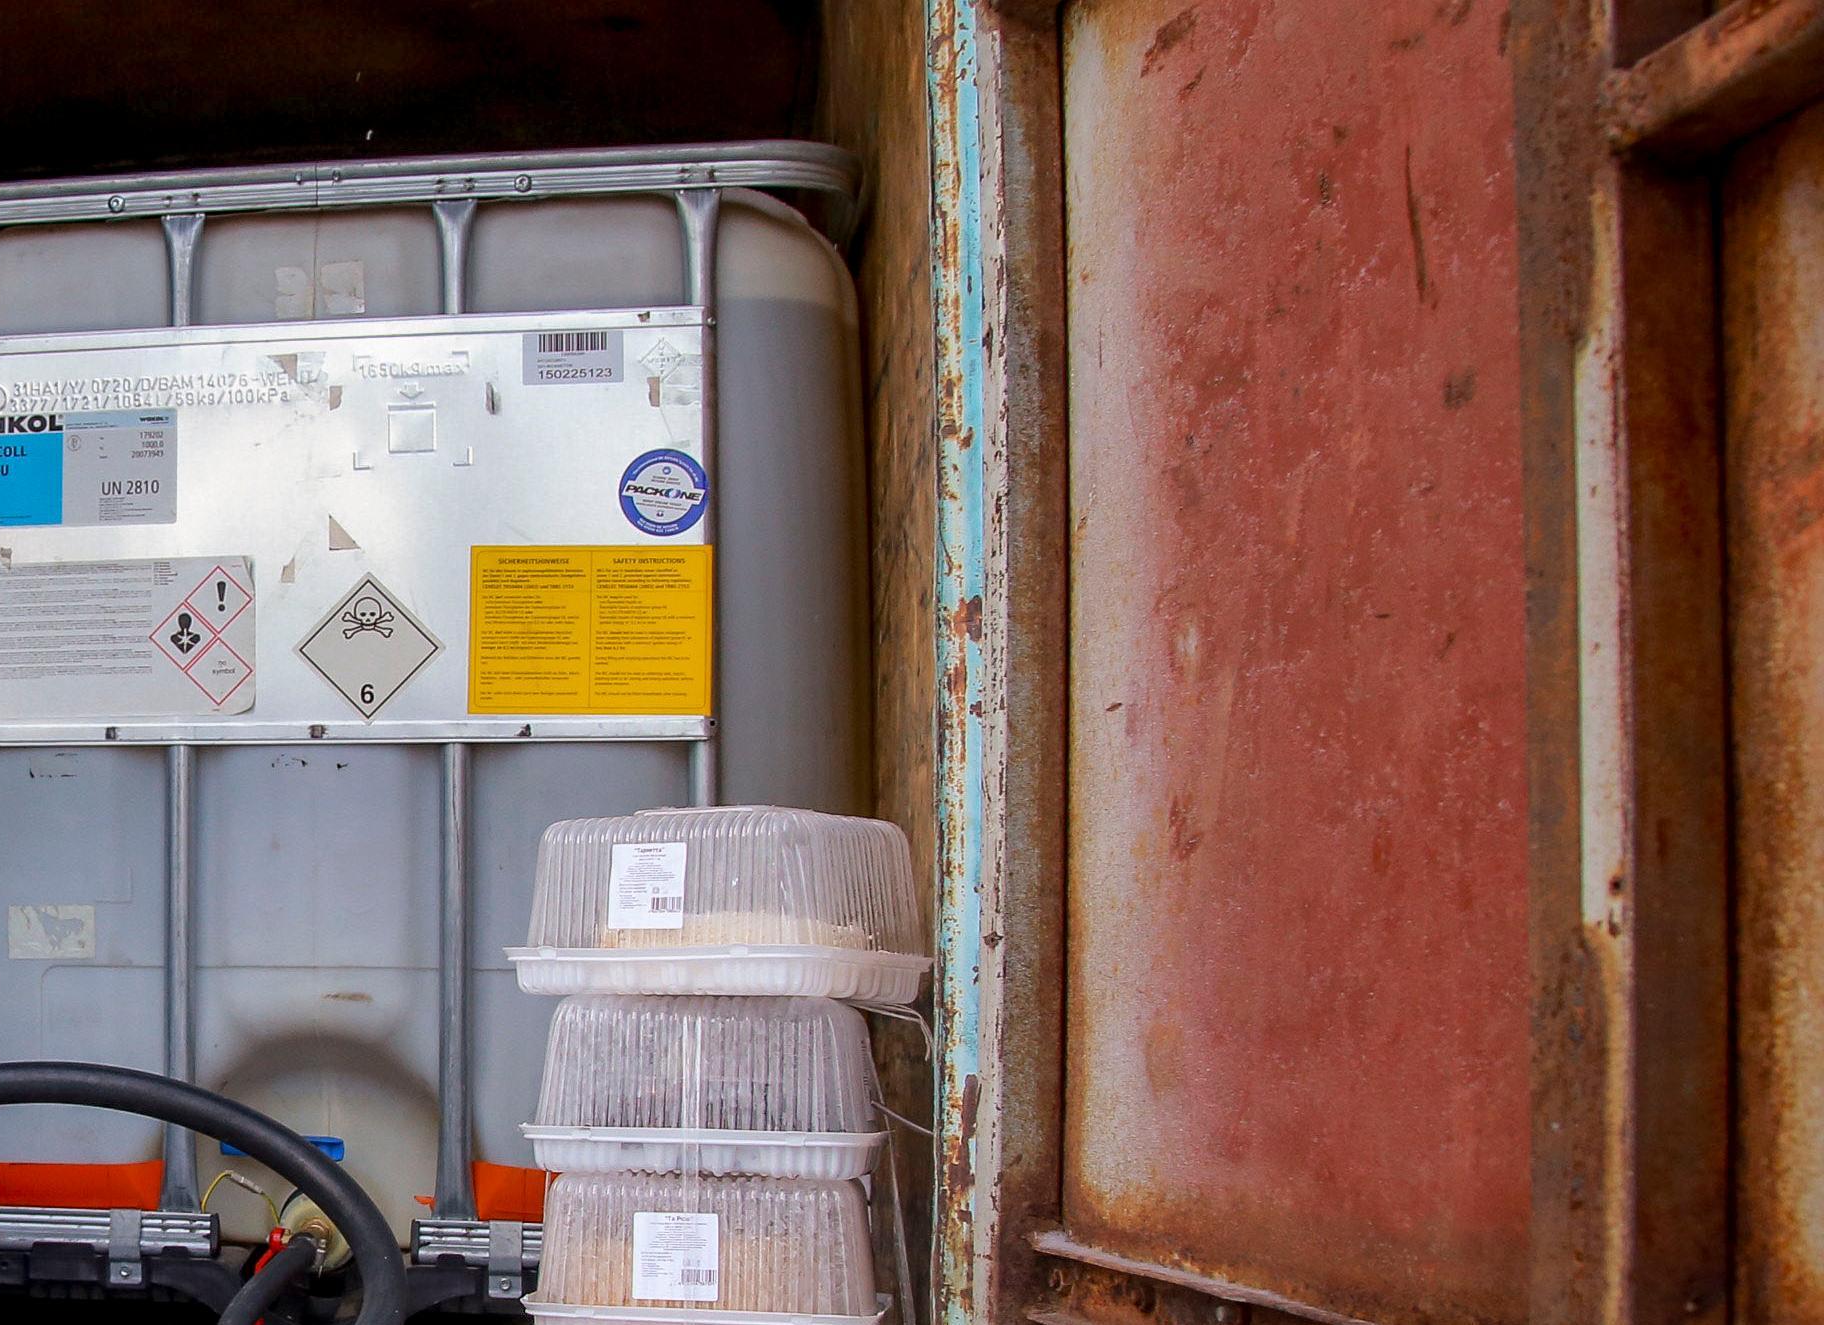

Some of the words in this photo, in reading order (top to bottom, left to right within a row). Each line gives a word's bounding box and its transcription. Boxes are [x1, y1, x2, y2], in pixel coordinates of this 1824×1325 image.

[538, 367, 613, 380] 150225123
[1, 464, 9, 477] U
[101, 480, 122, 496] UN
[126, 479, 160, 495] 2810
[625, 484, 702, 502] PACKONE
[612, 557, 636, 565] SAFETY
[638, 557, 686, 565] INSTRUCTIONS
[361, 683, 375, 704] 6
